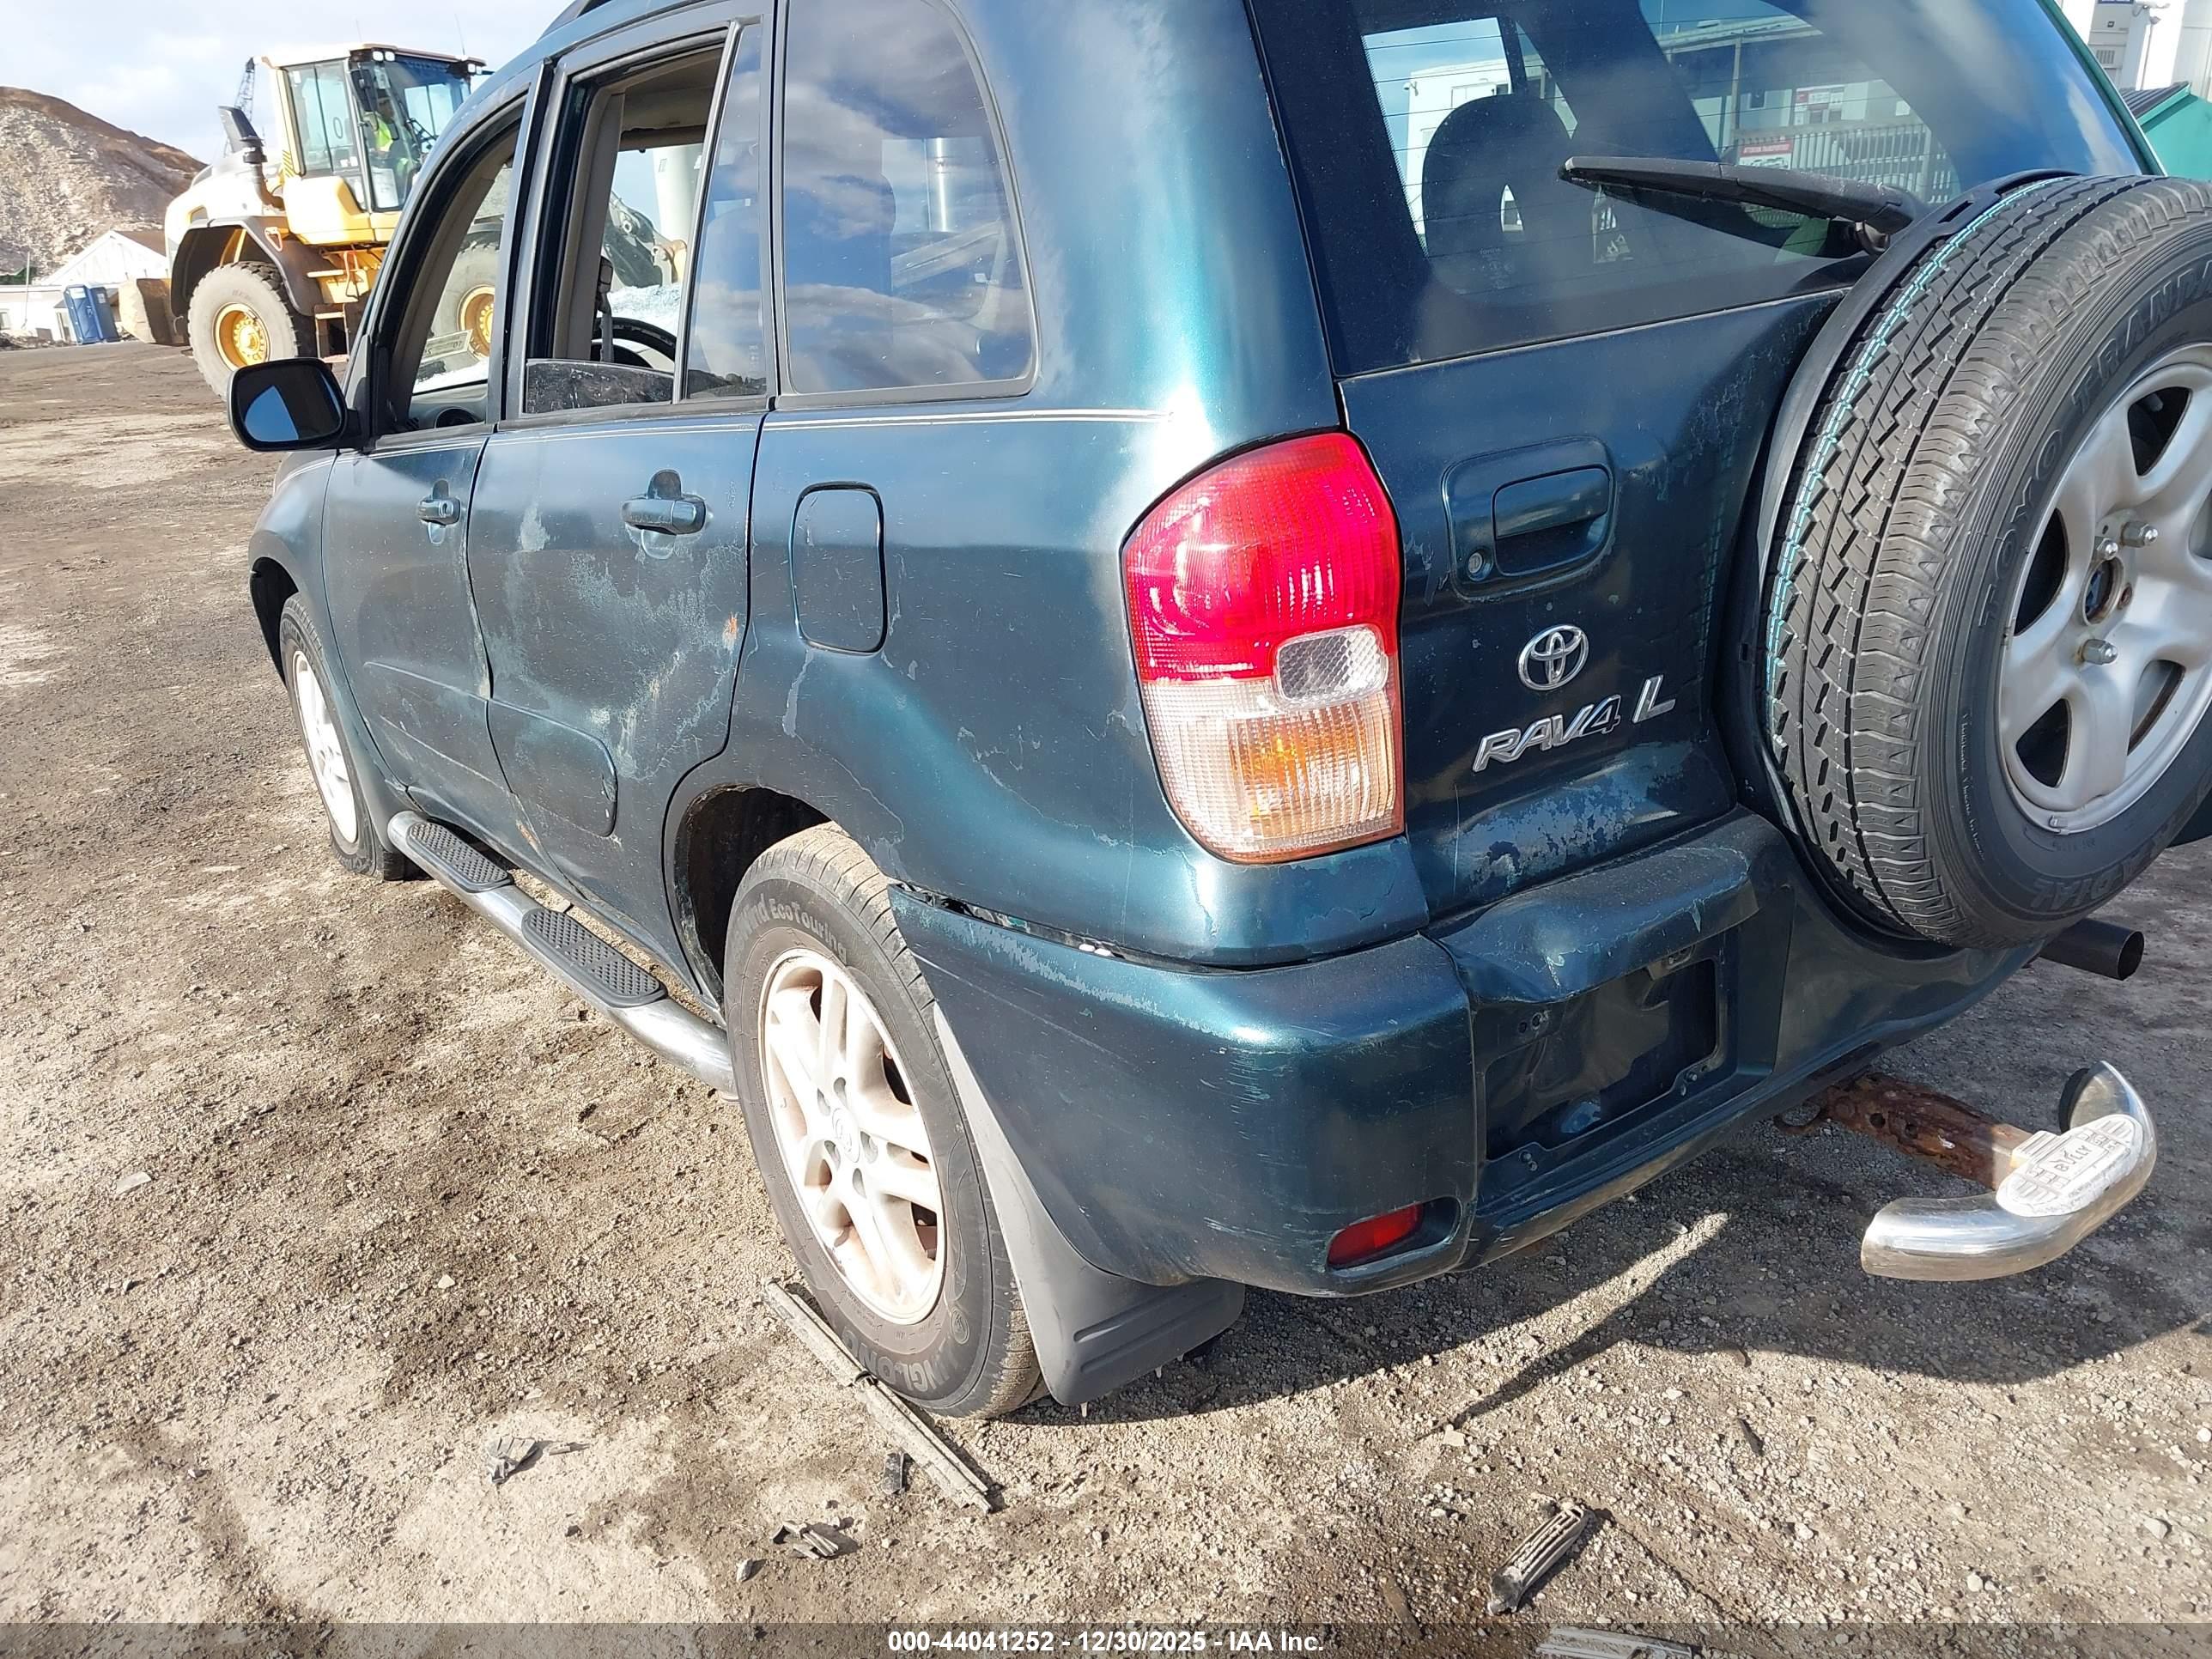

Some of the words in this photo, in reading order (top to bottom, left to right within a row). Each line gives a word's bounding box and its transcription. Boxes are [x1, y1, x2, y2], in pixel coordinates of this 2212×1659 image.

[1978, 428, 2062, 628] TOYO
[1473, 694, 1622, 772] RAV4
[1632, 674, 1677, 724] L
[769, 897, 847, 964] EcoTouring
